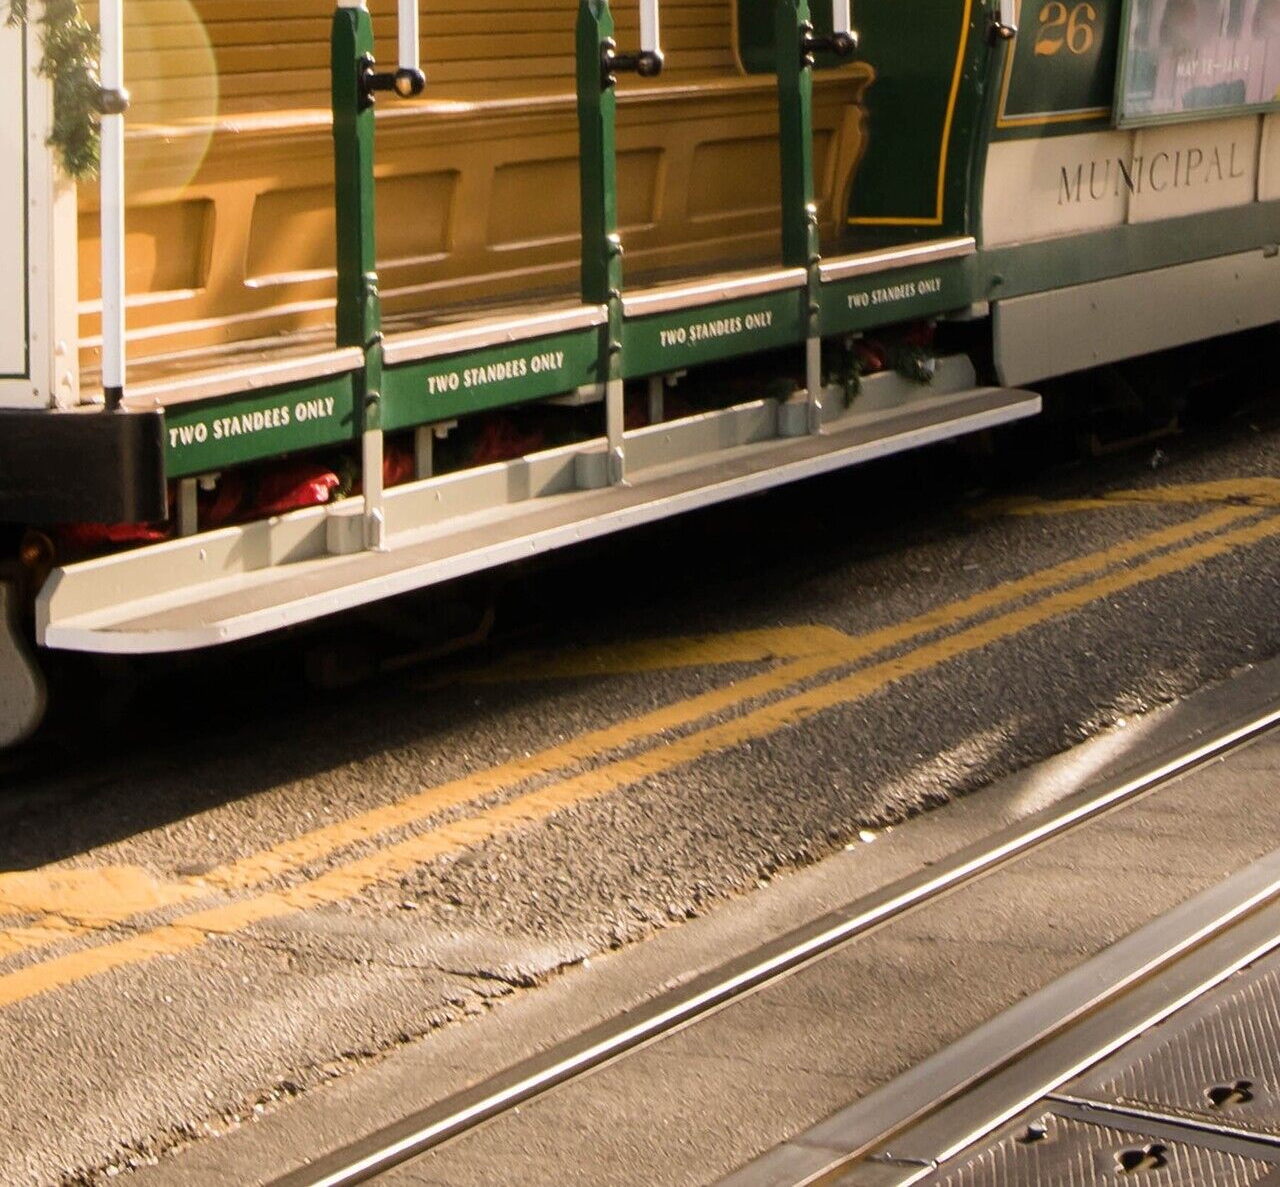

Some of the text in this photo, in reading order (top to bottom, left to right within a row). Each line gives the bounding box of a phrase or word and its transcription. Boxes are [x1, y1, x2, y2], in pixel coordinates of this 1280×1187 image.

[1034, 1, 1096, 56] 26
[1058, 142, 1244, 205] MUNICIPAL
[847, 278, 941, 309] TWO STANDEES ONLY
[660, 310, 772, 347] TWO STANDEES ONLY
[427, 351, 564, 394] TWO STANDEES ONLY
[168, 397, 334, 448] TWO STANDEES ONLY
